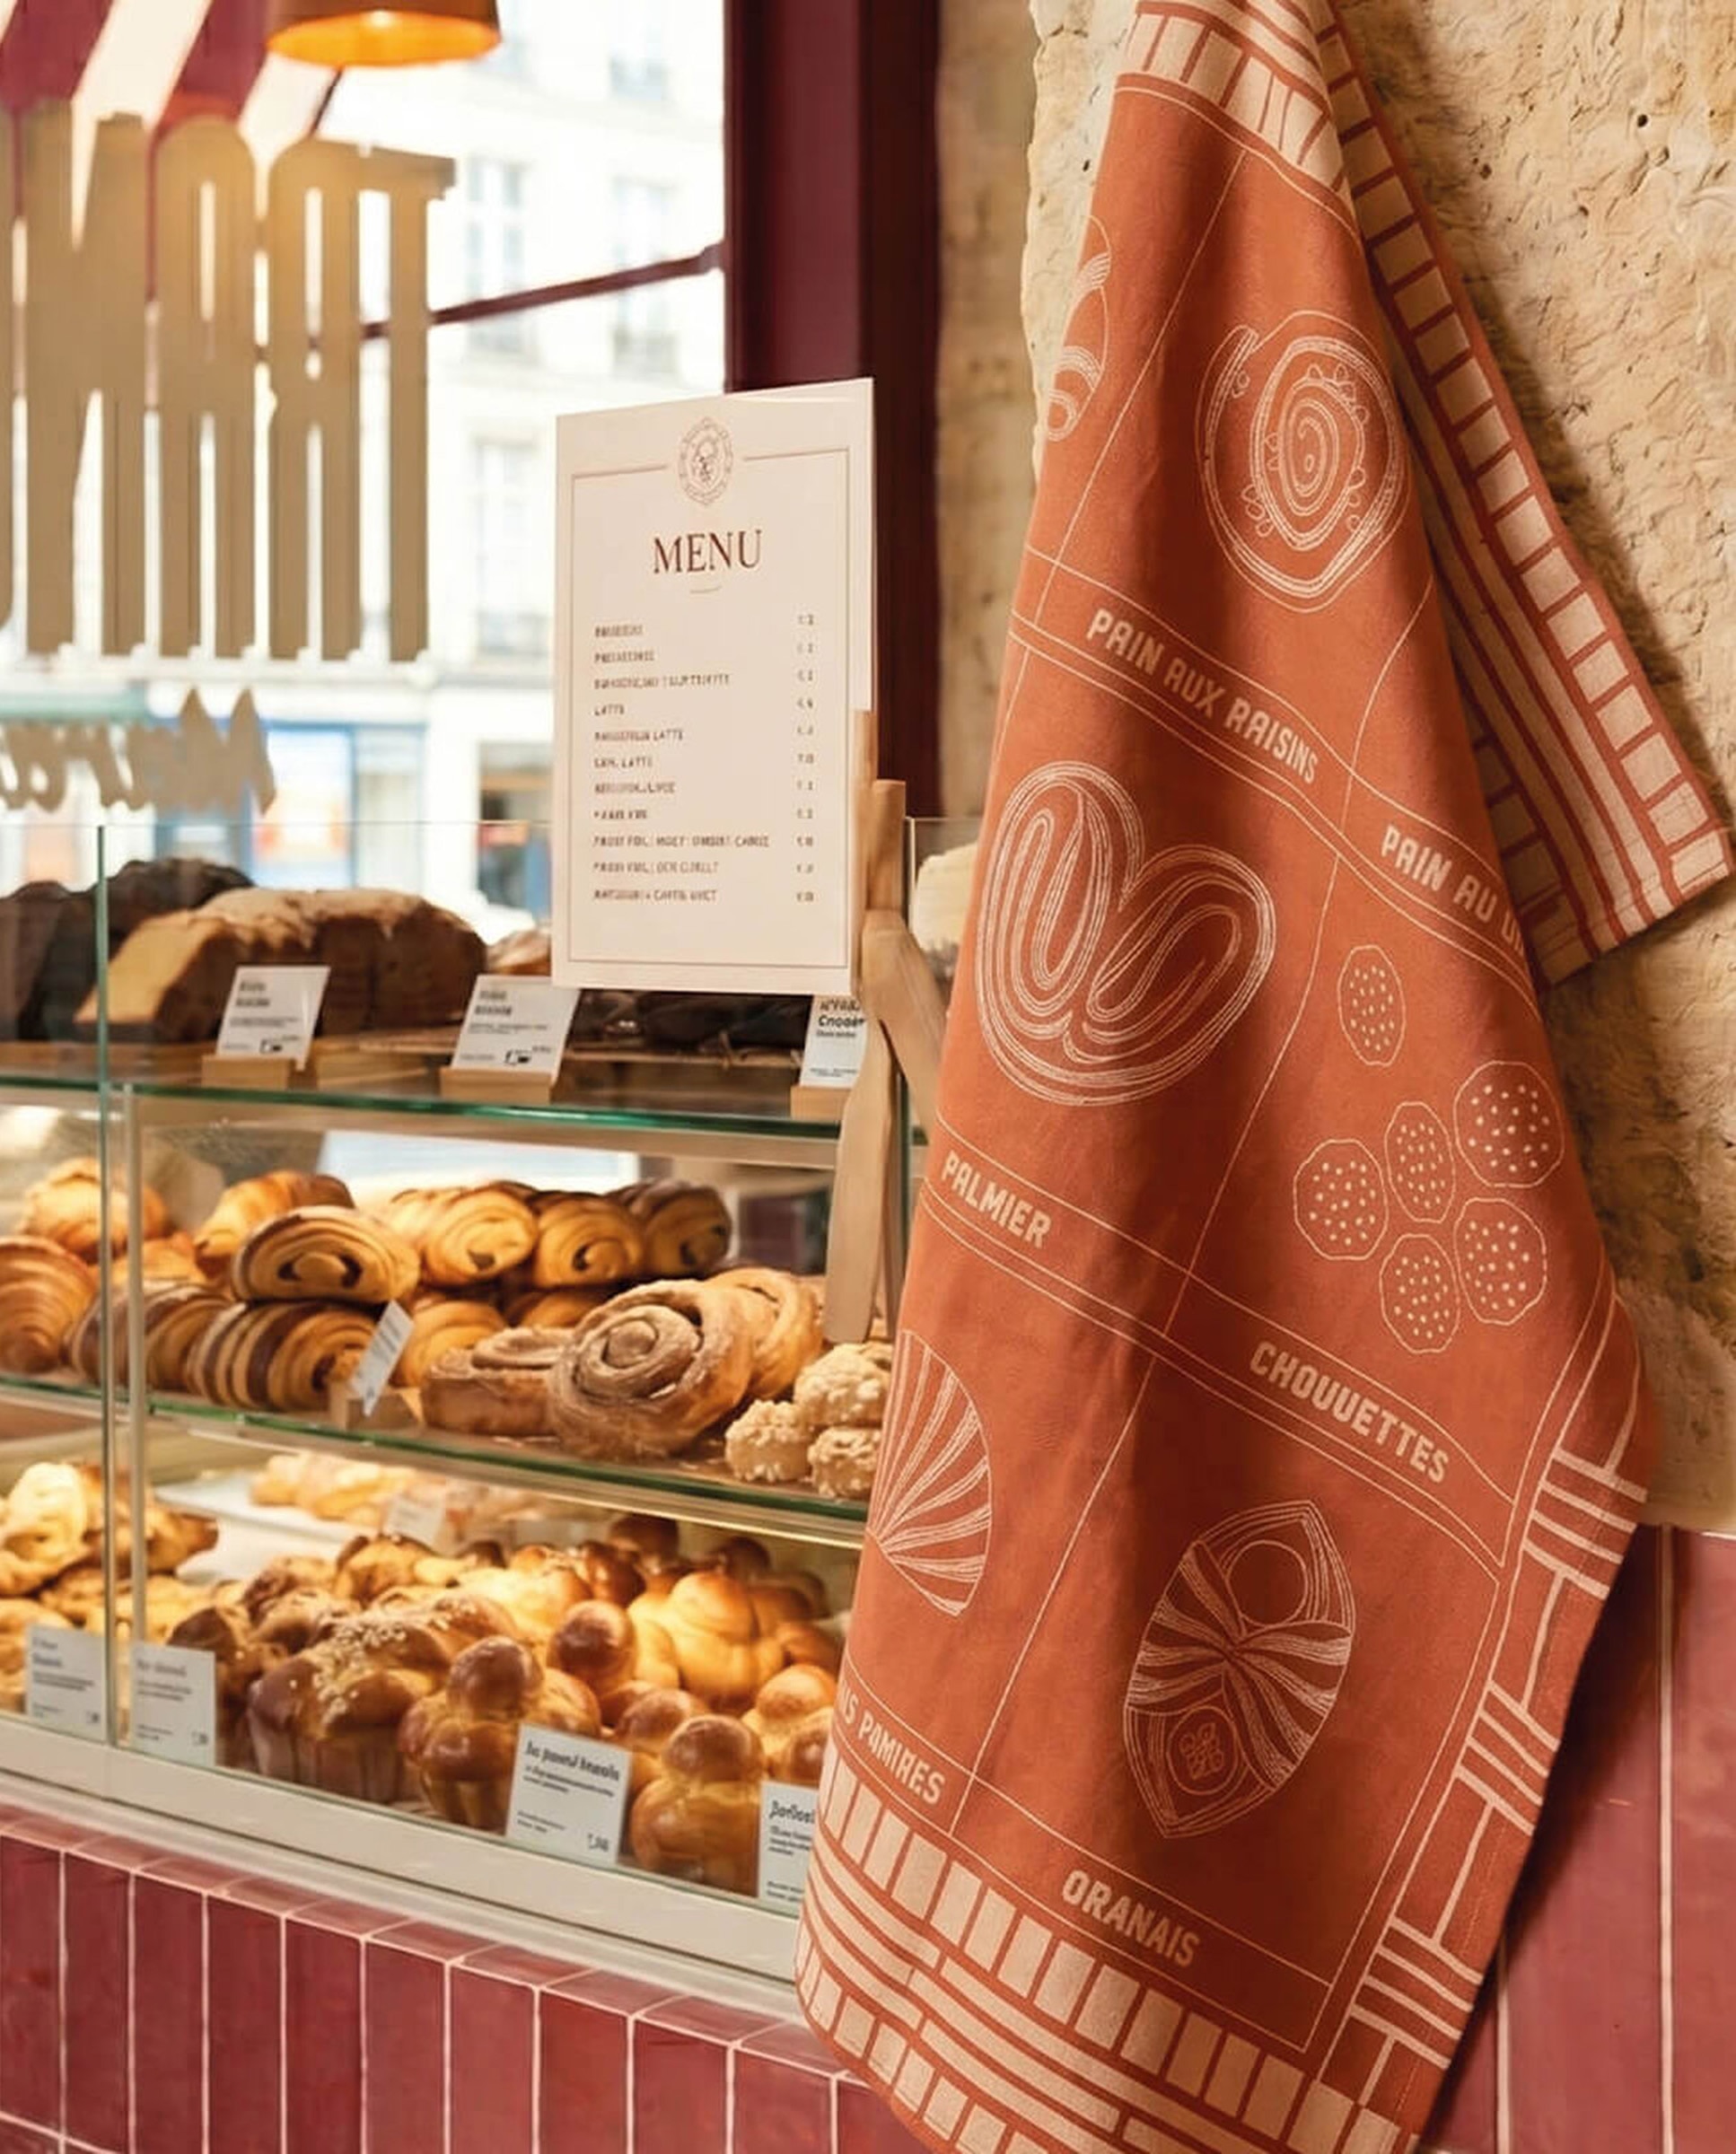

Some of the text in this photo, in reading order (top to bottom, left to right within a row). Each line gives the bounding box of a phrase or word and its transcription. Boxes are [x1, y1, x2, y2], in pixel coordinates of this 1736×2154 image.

[652, 529, 762, 575] MENU
[1086, 608, 1320, 784] PAIN AUX RAISINS
[1381, 824, 1452, 891] PAIN
[1452, 874, 1497, 924] AU
[941, 1149, 1051, 1249] PALMIER
[1062, 1869, 1201, 1968] ORANAIS
